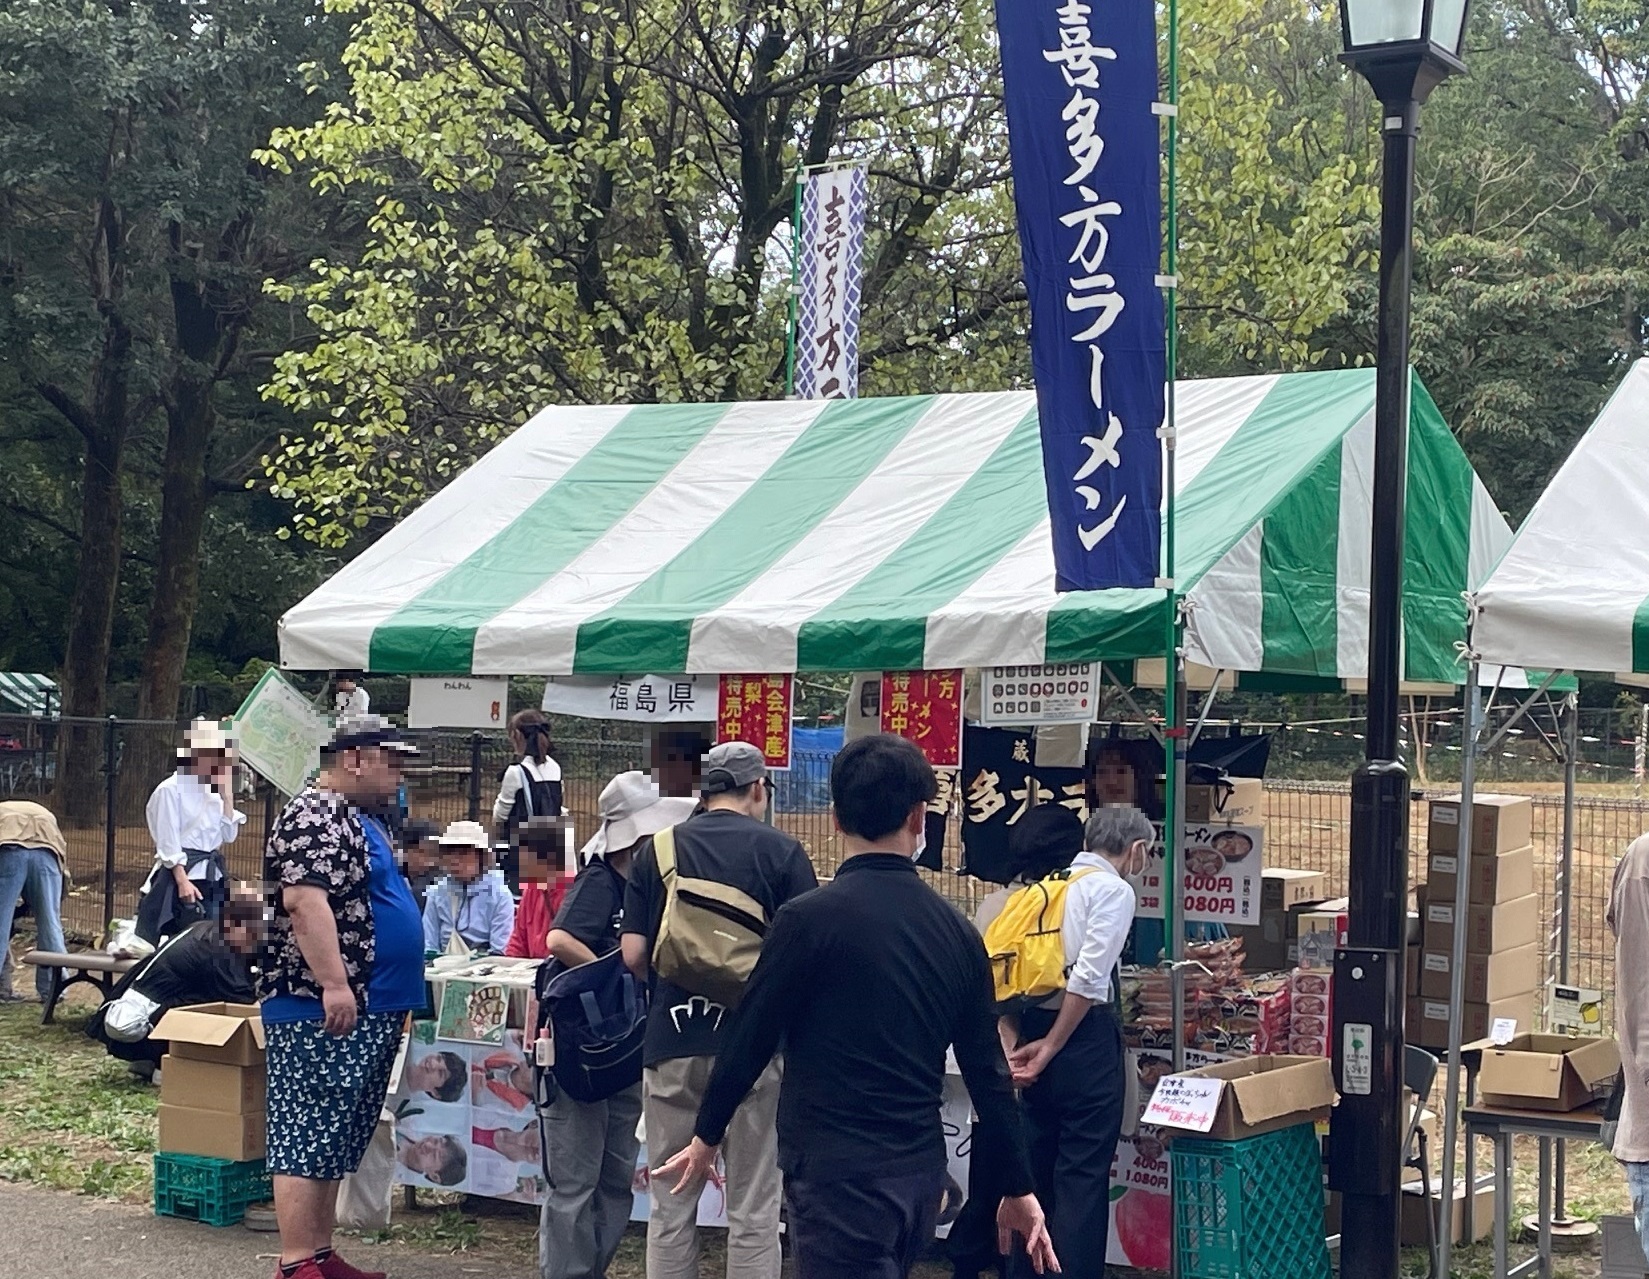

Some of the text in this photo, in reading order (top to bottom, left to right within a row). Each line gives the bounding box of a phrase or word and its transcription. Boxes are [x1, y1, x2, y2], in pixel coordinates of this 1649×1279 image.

[1043, 0, 1127, 551] 喜多方ラーメン
[609, 681, 695, 713] 福島県
[745, 682, 762, 704] 梨
[918, 671, 932, 739] ーメン
